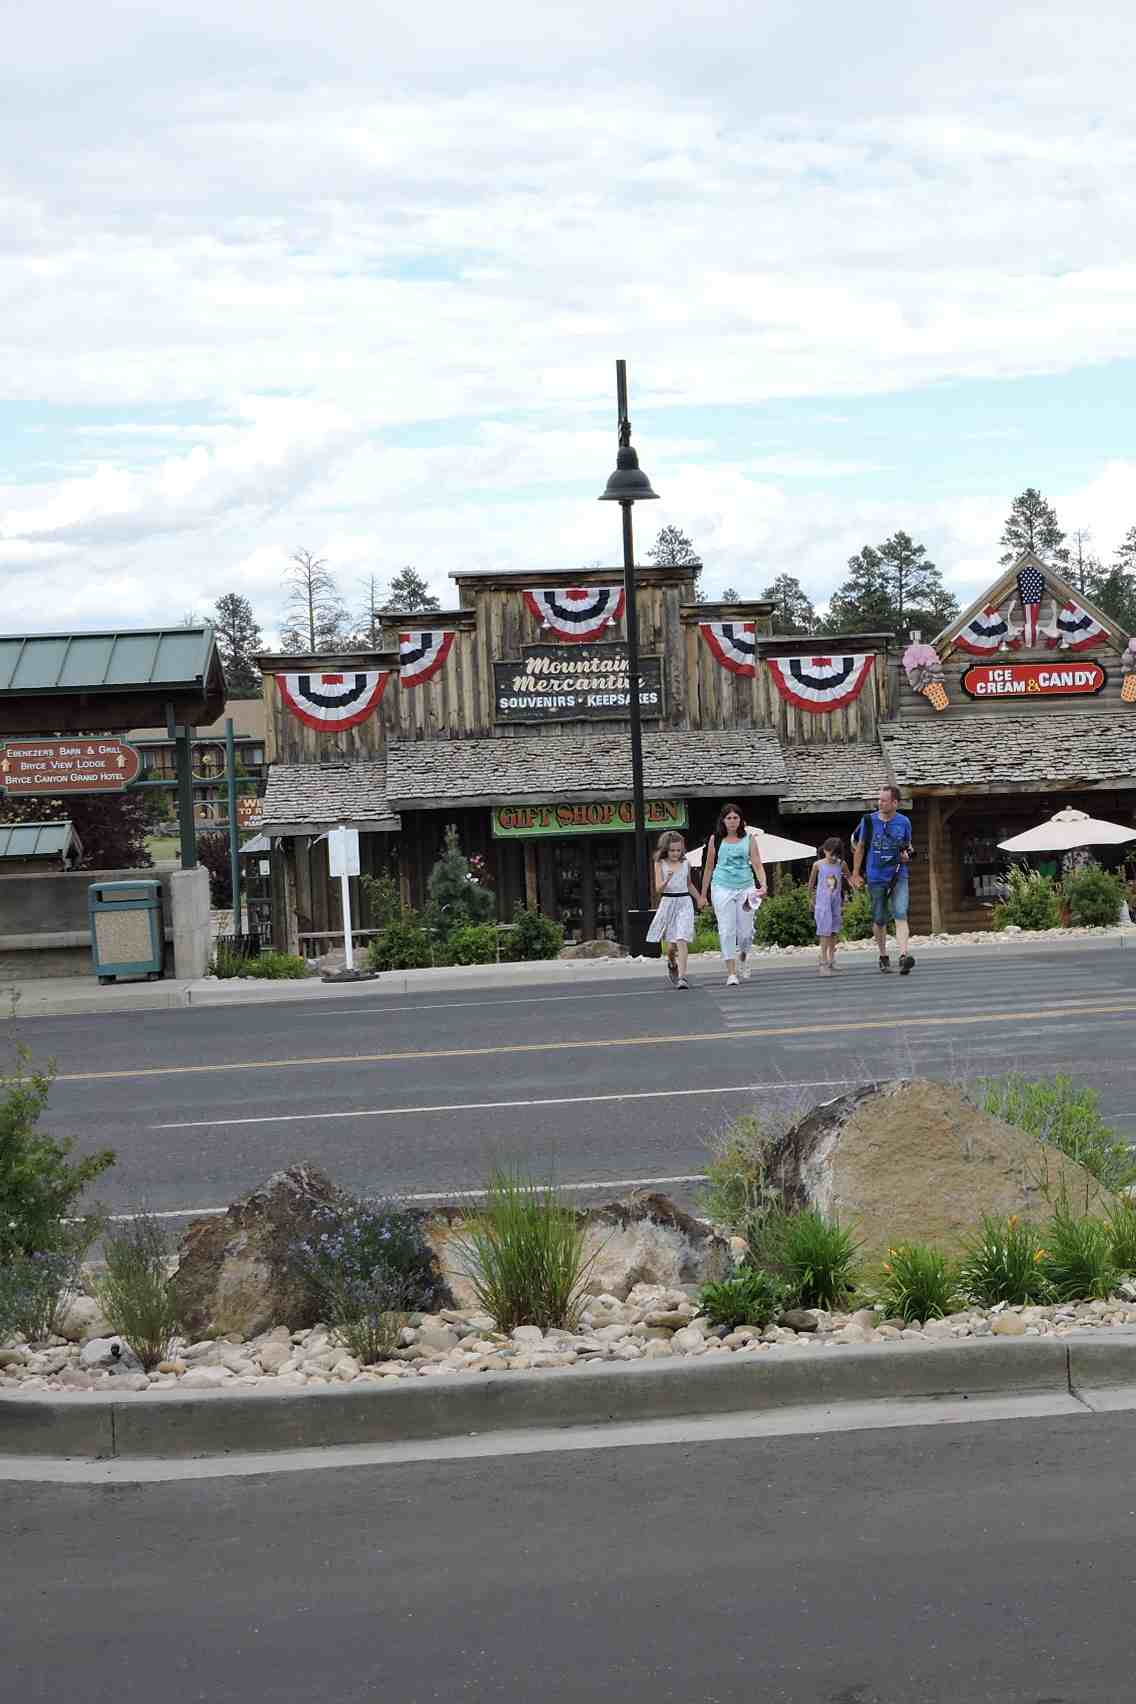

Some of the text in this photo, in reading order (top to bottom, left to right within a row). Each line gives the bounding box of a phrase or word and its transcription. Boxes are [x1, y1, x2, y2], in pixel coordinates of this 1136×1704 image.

[988, 669, 1013, 681] ICE
[512, 673, 647, 692] Mercantie
[976, 671, 1097, 694] CREAM & CANDY
[499, 695, 576, 709] SOUVENIRS
[20, 759, 106, 771] BRYCE VIEW LODGE
[5, 771, 124, 785] BRYCE CANYON GRAND HOTEL
[498, 800, 678, 829] GIFT SHOP OEN
